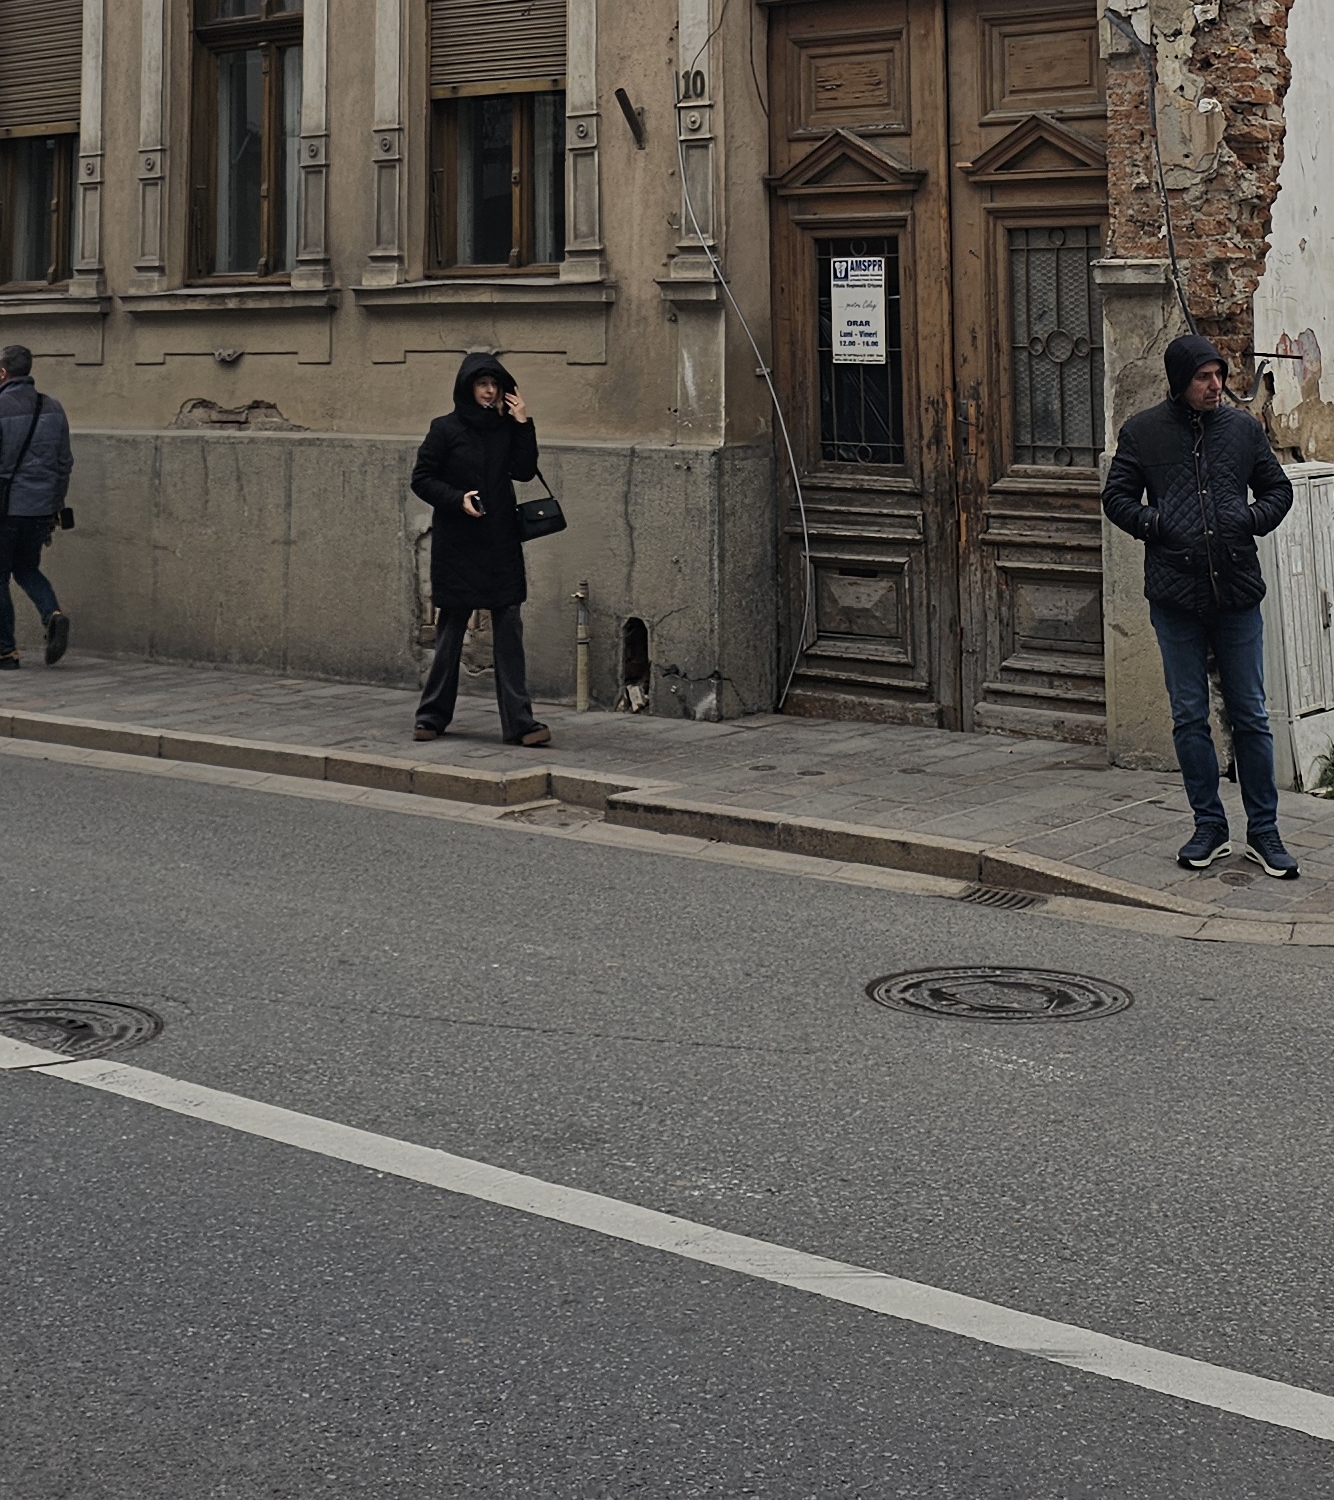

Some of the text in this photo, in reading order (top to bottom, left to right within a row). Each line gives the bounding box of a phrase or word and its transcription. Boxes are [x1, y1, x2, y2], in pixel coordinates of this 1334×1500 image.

[681, 69, 706, 99] 10
[850, 260, 882, 272] AMSPPR
[859, 330, 878, 338] Vineri
